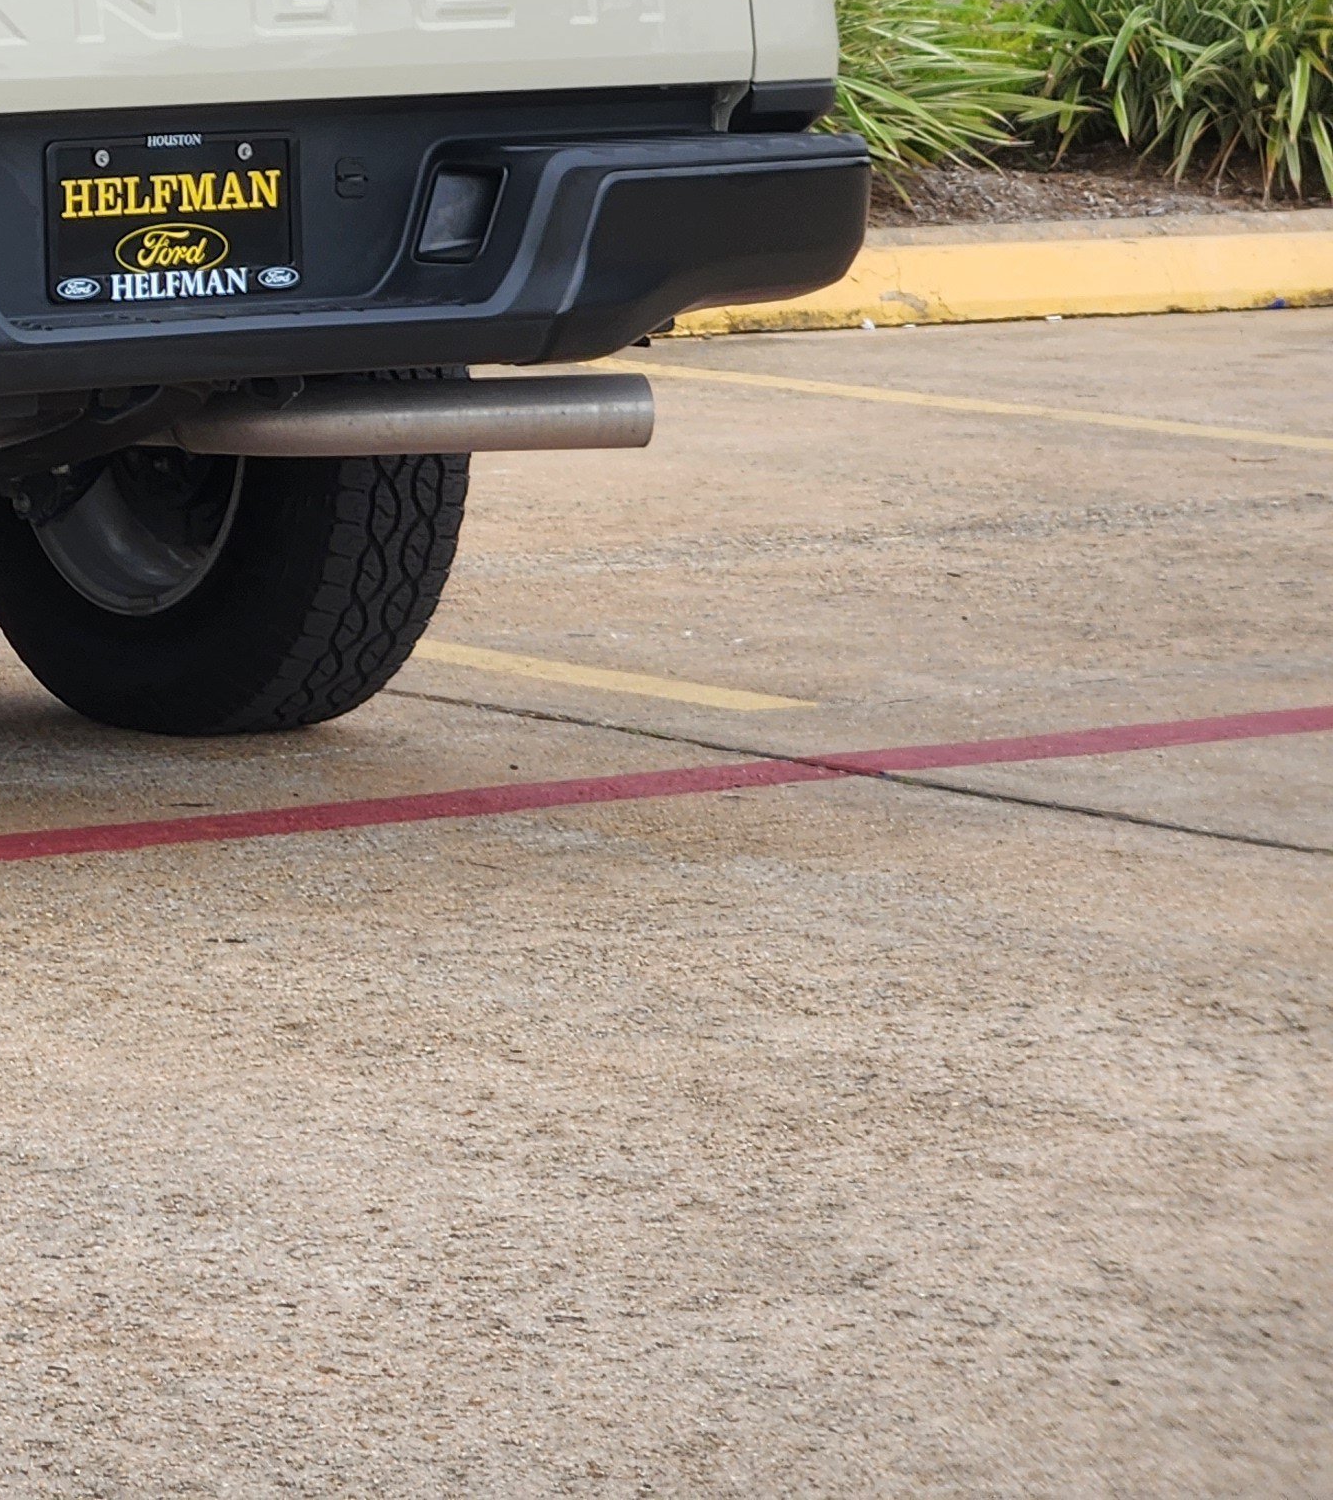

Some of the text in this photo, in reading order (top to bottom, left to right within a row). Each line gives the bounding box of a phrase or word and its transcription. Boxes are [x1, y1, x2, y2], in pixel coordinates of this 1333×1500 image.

[146, 133, 202, 148] HOUSTON
[60, 169, 282, 219] HELFMAN
[136, 229, 207, 268] Ford
[110, 267, 248, 301] HELFMAN
